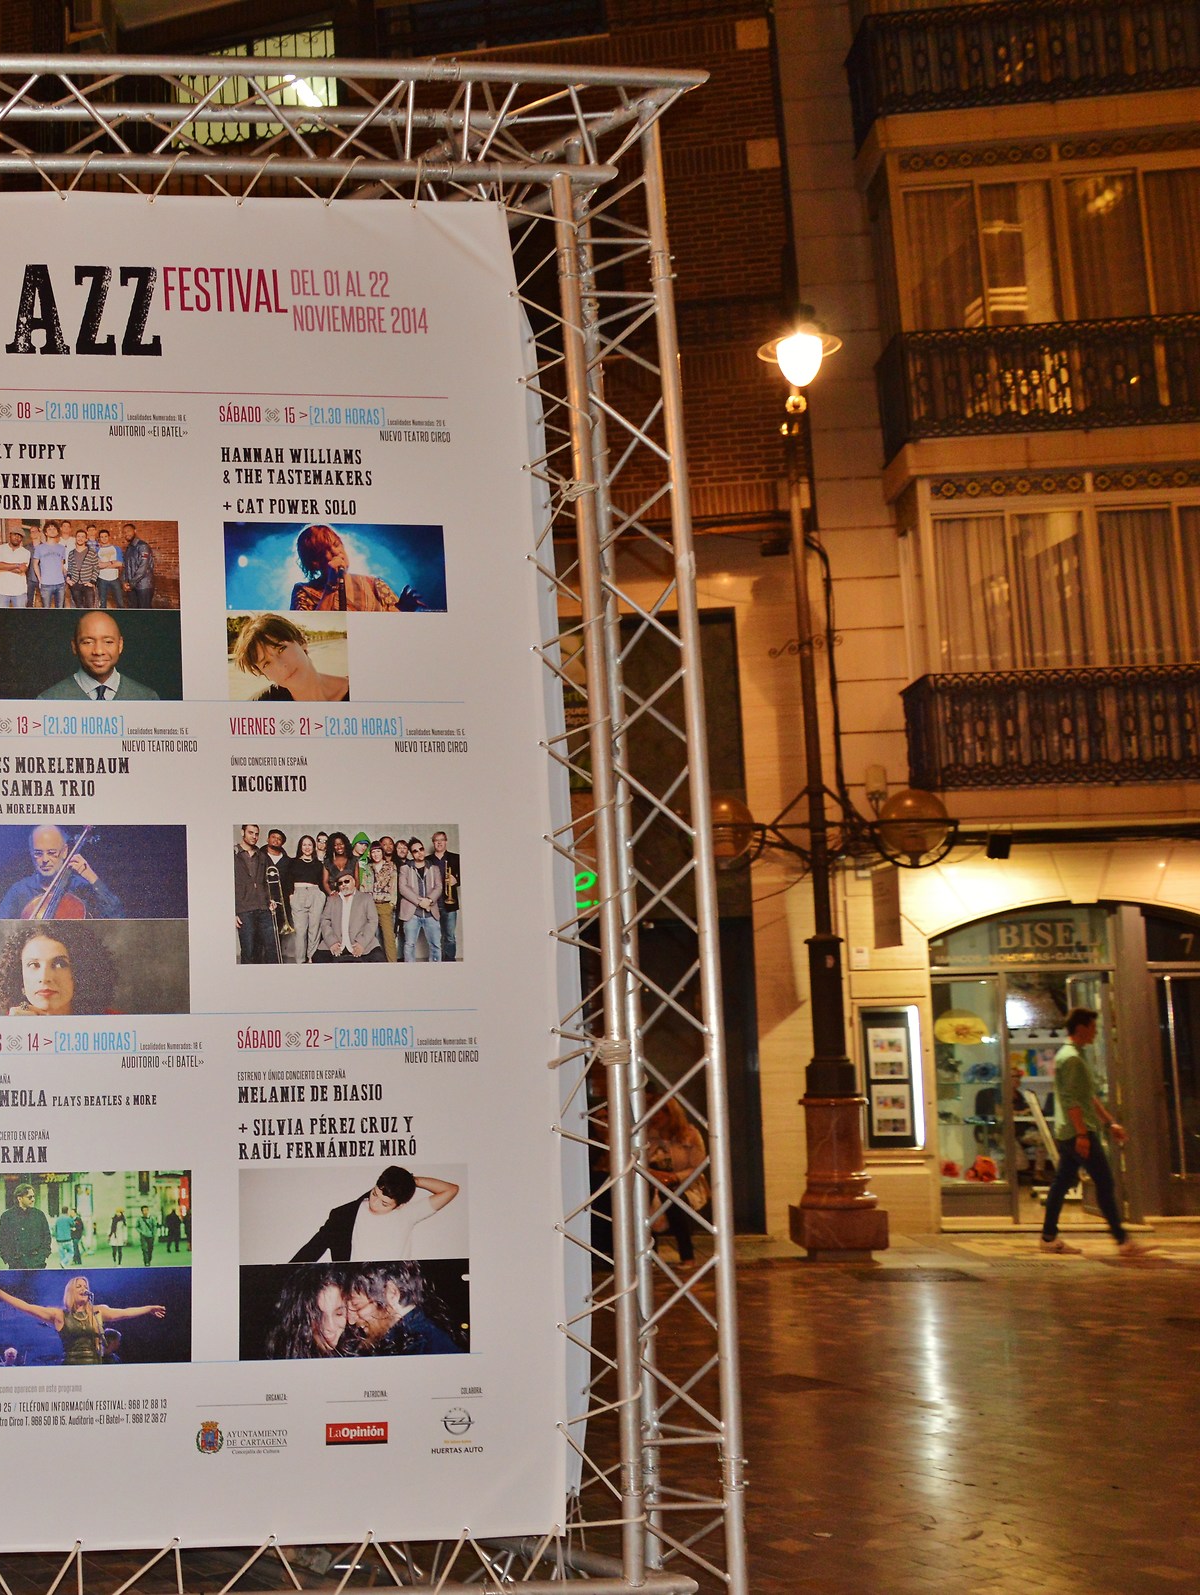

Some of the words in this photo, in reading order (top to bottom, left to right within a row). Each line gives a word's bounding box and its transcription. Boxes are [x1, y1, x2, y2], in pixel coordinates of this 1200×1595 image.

[163, 267, 288, 314] FESTIVAL
[291, 269, 320, 296] DEL
[325, 270, 341, 297] 01
[345, 271, 366, 297] AL
[369, 271, 390, 298] 22
[293, 305, 387, 334] NOVIEMBRE
[391, 306, 428, 334] 2014
[17, 401, 31, 419] 08
[219, 402, 262, 423] SÁBADO
[284, 407, 295, 424] 15
[109, 425, 145, 437] AUDITORIO
[19, 444, 67, 460] PUPPY
[221, 447, 284, 464] HANNAH
[289, 448, 362, 465] WILLIAMS
[61, 474, 100, 491] WITH
[223, 470, 231, 484] &
[235, 468, 263, 484] THE
[267, 469, 372, 486] TASTEMAKERS
[37, 495, 113, 512] MARSALIS
[237, 498, 264, 514] CAT
[269, 499, 320, 515] POWER
[325, 500, 356, 515] SOLO
[17, 716, 28, 734] 13
[230, 717, 276, 736] VIERNES
[299, 717, 311, 735] 21
[14, 757, 130, 774] MORELENBAUM
[1, 780, 54, 797] SAMBA
[59, 780, 95, 797] TRIO
[231, 775, 307, 792] INCOGNITO
[6, 804, 76, 815] MORELENBAUM
[1000, 922, 1100, 947] BISEL
[1180, 933, 1194, 954] 7
[28, 1033, 39, 1051] 14
[237, 1026, 281, 1049] SÁBADO
[305, 1029, 320, 1048] 22
[0, 1090, 47, 1107] MEOLA
[52, 1096, 81, 1107] PLAYS
[84, 1096, 122, 1106] BEATLES
[133, 1095, 157, 1105] MORE
[238, 1085, 305, 1104] MELANIE
[310, 1085, 328, 1102] DE
[333, 1083, 382, 1101] BIASIO
[253, 1118, 304, 1136] SILVIA
[310, 1113, 355, 1134] PÉREZ
[360, 1116, 398, 1133] CRUZ
[403, 1116, 414, 1133] Y
[238, 1139, 281, 1160] RAÜL
[286, 1137, 375, 1158] FERNÁNDEZ
[380, 1135, 417, 1156] MIRÓ
[4, 1402, 11, 1412] 25
[19, 1400, 49, 1412] TELÉFONO
[52, 1399, 93, 1411] INFORMACIÓN
[96, 1400, 126, 1410] FESTIVAL:
[128, 1400, 140, 1409] 968
[142, 1400, 148, 1409] 12
[151, 1399, 158, 1409] 88
[161, 1399, 167, 1409] 13
[227, 1430, 287, 1438] AYUNTAMIENTO
